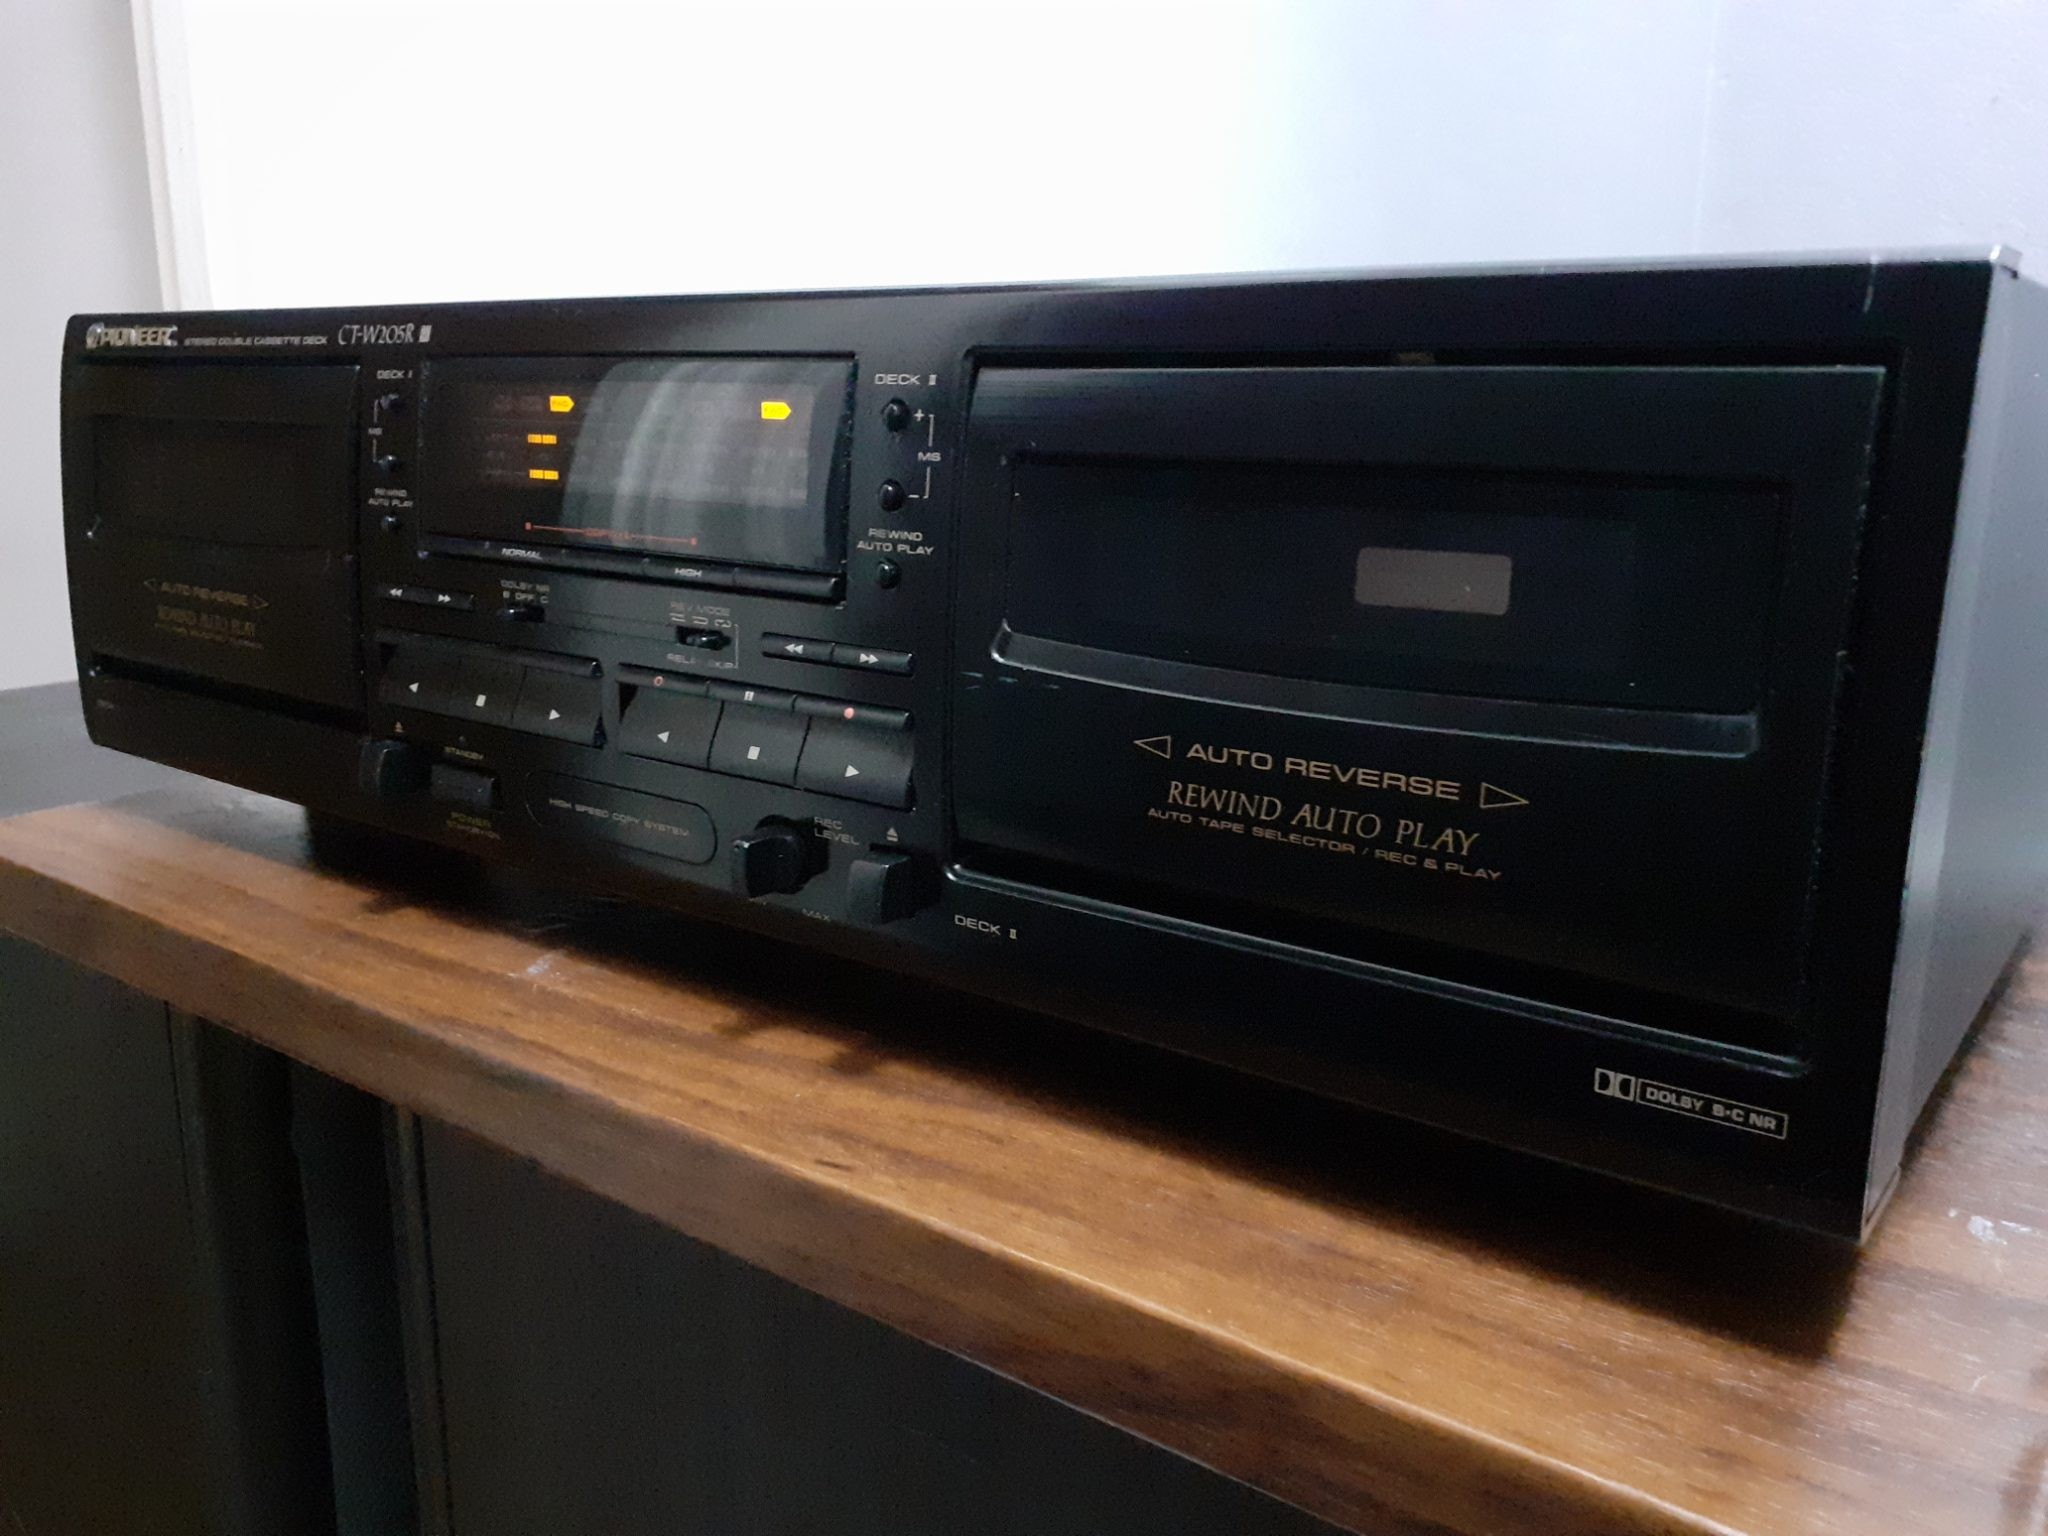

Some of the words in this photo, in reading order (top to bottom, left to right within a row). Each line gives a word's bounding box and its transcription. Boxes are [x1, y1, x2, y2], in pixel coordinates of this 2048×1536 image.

[253, 336, 300, 345] CASSETTE
[302, 336, 328, 344] DECK
[376, 370, 405, 379] DECK
[874, 374, 920, 385] DECK
[917, 451, 942, 463] MS
[391, 499, 414, 508] PLAY
[868, 528, 923, 542] REWIND
[501, 547, 543, 560] NORMAL
[856, 540, 893, 553] AUTO
[896, 543, 935, 556] PLAY
[674, 567, 702, 578] HIGH
[1186, 742, 1275, 772] AUTO
[1284, 756, 1462, 801] REVERSE
[611, 811, 641, 826] COPY
[643, 819, 690, 838] SYSTEM
[814, 816, 842, 830] REC
[1167, 780, 1283, 822] REWIND
[1291, 802, 1382, 839] AUTO
[1396, 818, 1481, 857] PLAY
[814, 827, 860, 846] LEVEL
[1147, 807, 1193, 825] AUTO
[1199, 816, 1246, 835] TAPE
[1251, 825, 1357, 856] SELECTOR
[1374, 849, 1418, 867] REC
[1444, 861, 1502, 882] PLAY
[954, 914, 1002, 937] DECK
[1645, 1086, 1704, 1112] DOLBY
[1748, 1111, 1777, 1131] NR
